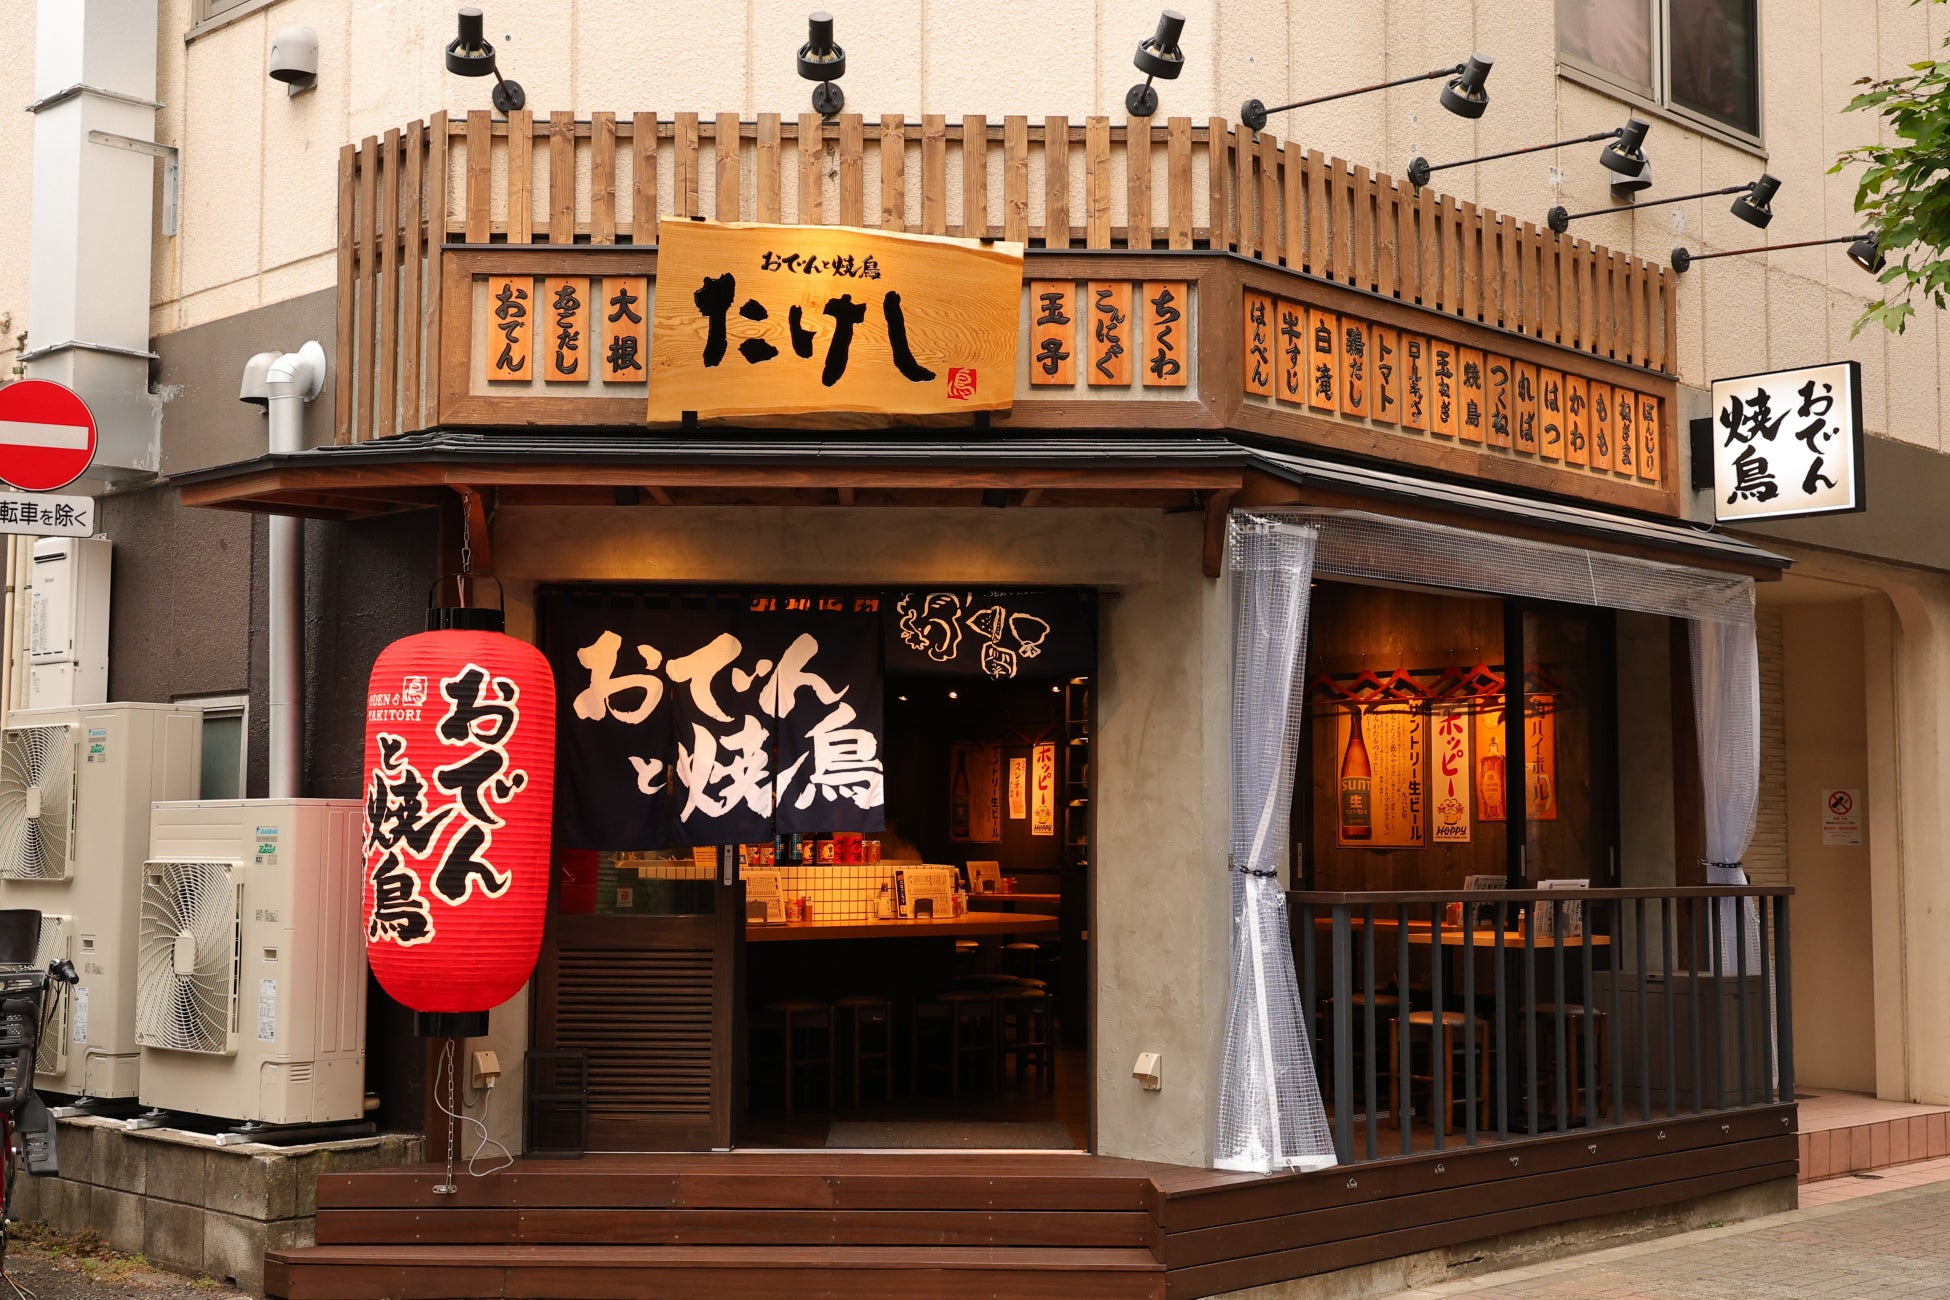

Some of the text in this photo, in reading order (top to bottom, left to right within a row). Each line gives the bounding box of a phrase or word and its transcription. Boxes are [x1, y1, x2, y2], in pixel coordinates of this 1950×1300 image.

[761, 251, 881, 280] おでんと焼鳥
[495, 286, 529, 371] おでん
[552, 285, 580, 375] あごだし
[608, 289, 642, 373] 大根
[694, 272, 937, 387] たけし
[1037, 292, 1070, 375] 玉子
[1095, 290, 1126, 379] こんにゃく
[1151, 289, 1180, 378] ちくわ
[1250, 300, 1268, 387] はんぺん
[1281, 310, 1302, 395] 牛すじ
[1315, 318, 1333, 401] 白滝
[1346, 326, 1365, 408] 鶏だし
[1379, 334, 1394, 412] トマト
[1408, 341, 1423, 423] ロールキャベツ
[1435, 350, 1453, 424] 玉ねぎ
[1463, 361, 1481, 428] 焼鳥
[1491, 365, 1509, 437] つくね
[1518, 369, 1535, 443] れば
[1545, 380, 1560, 445] はつ
[1569, 385, 1585, 453] かわ
[1596, 393, 1608, 457] もも
[1642, 401, 1655, 473] ぼんじり
[1720, 387, 1792, 505] 焼鳥
[1795, 380, 1840, 495] おでん
[0, 500, 87, 527] 転車を除く
[573, 630, 850, 723] おでん
[430, 663, 529, 906] おでん
[628, 702, 884, 822] と焼鳥
[1037, 744, 1052, 806] ホッピー
[1409, 703, 1421, 840] サントリー生ビール
[1439, 708, 1463, 798] ホッピー
[366, 732, 453, 946] と焼鳥
[1350, 794, 1362, 808] 生
